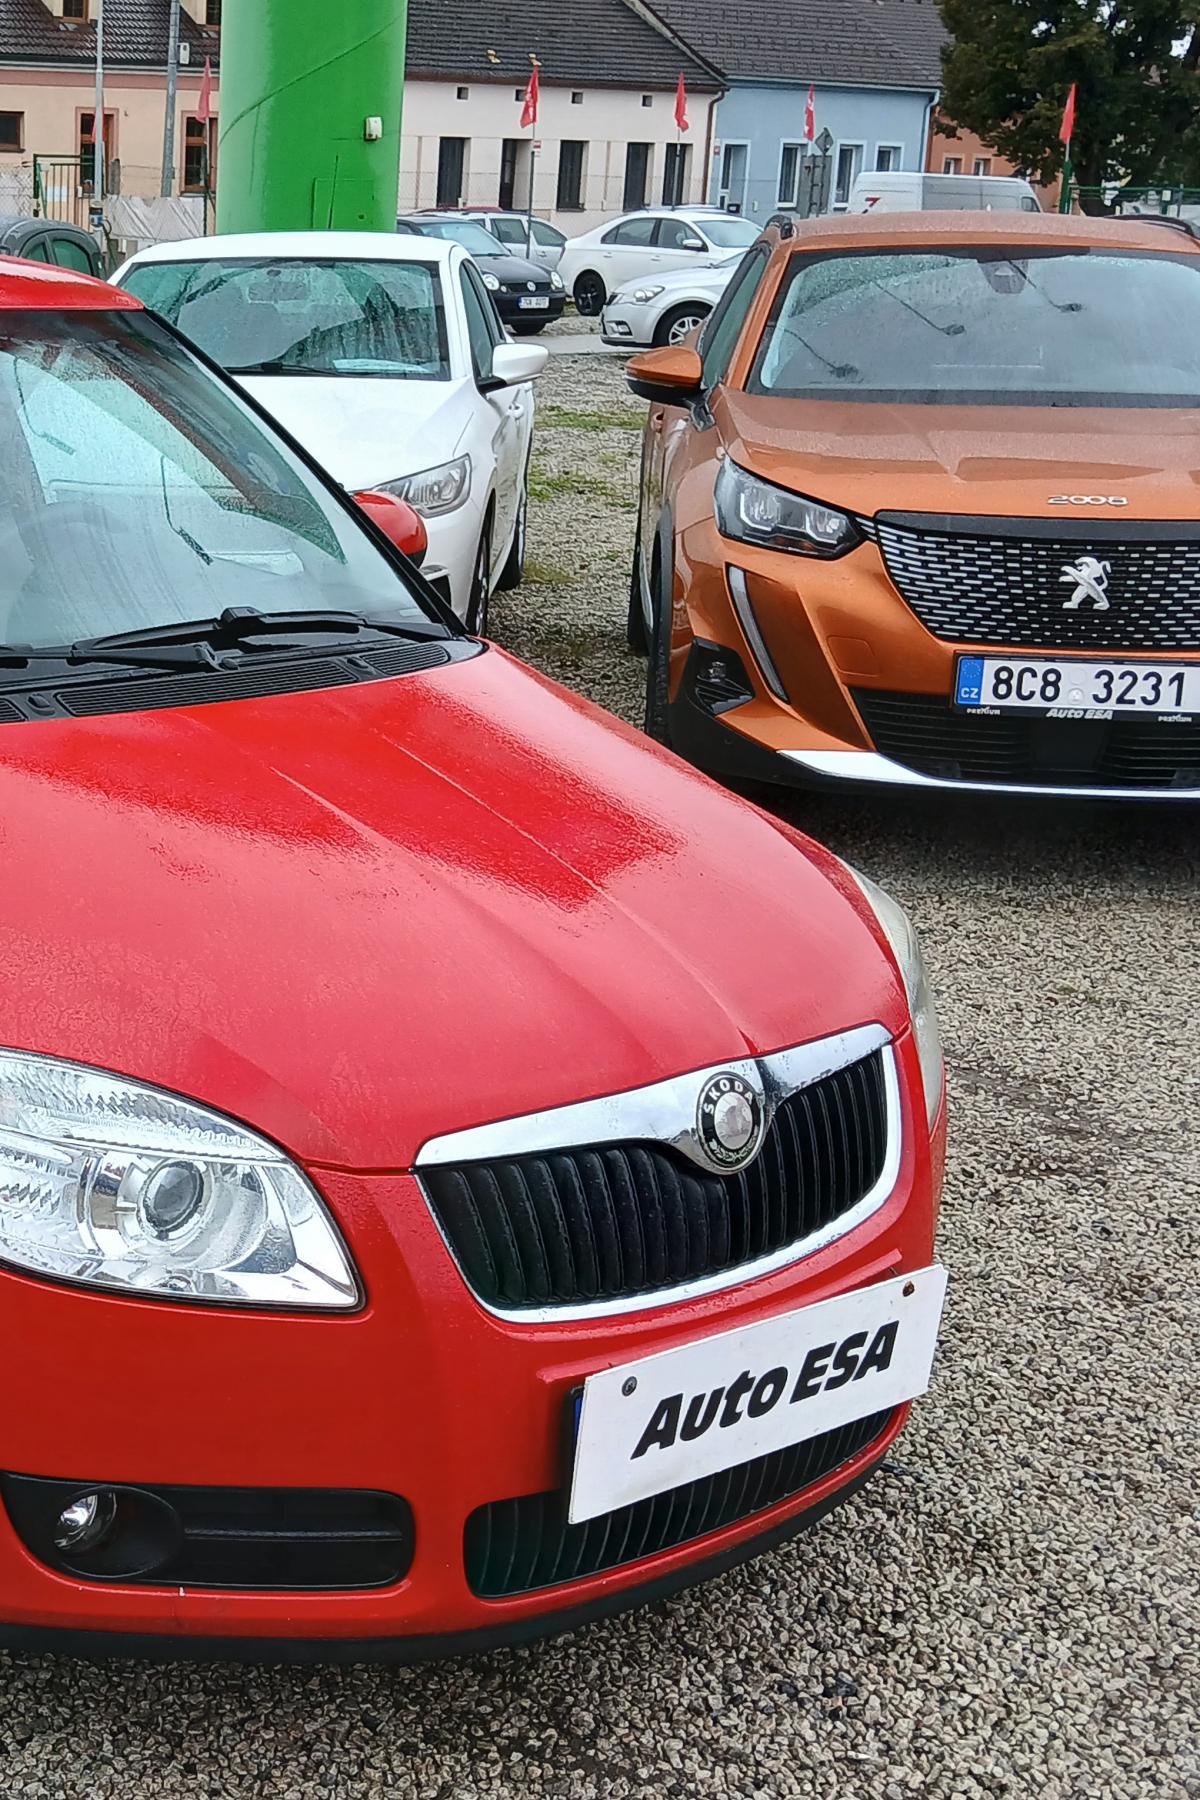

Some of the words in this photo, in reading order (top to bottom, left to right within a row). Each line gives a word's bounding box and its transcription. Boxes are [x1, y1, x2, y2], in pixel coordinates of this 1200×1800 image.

[1047, 495, 1129, 506] 2008
[992, 665, 1062, 703] 8C8
[1092, 669, 1186, 707] 3231
[960, 688, 979, 699] CZ
[1085, 709, 1114, 720] ESA
[630, 1366, 788, 1460] Auto
[789, 1320, 900, 1404] ESA
